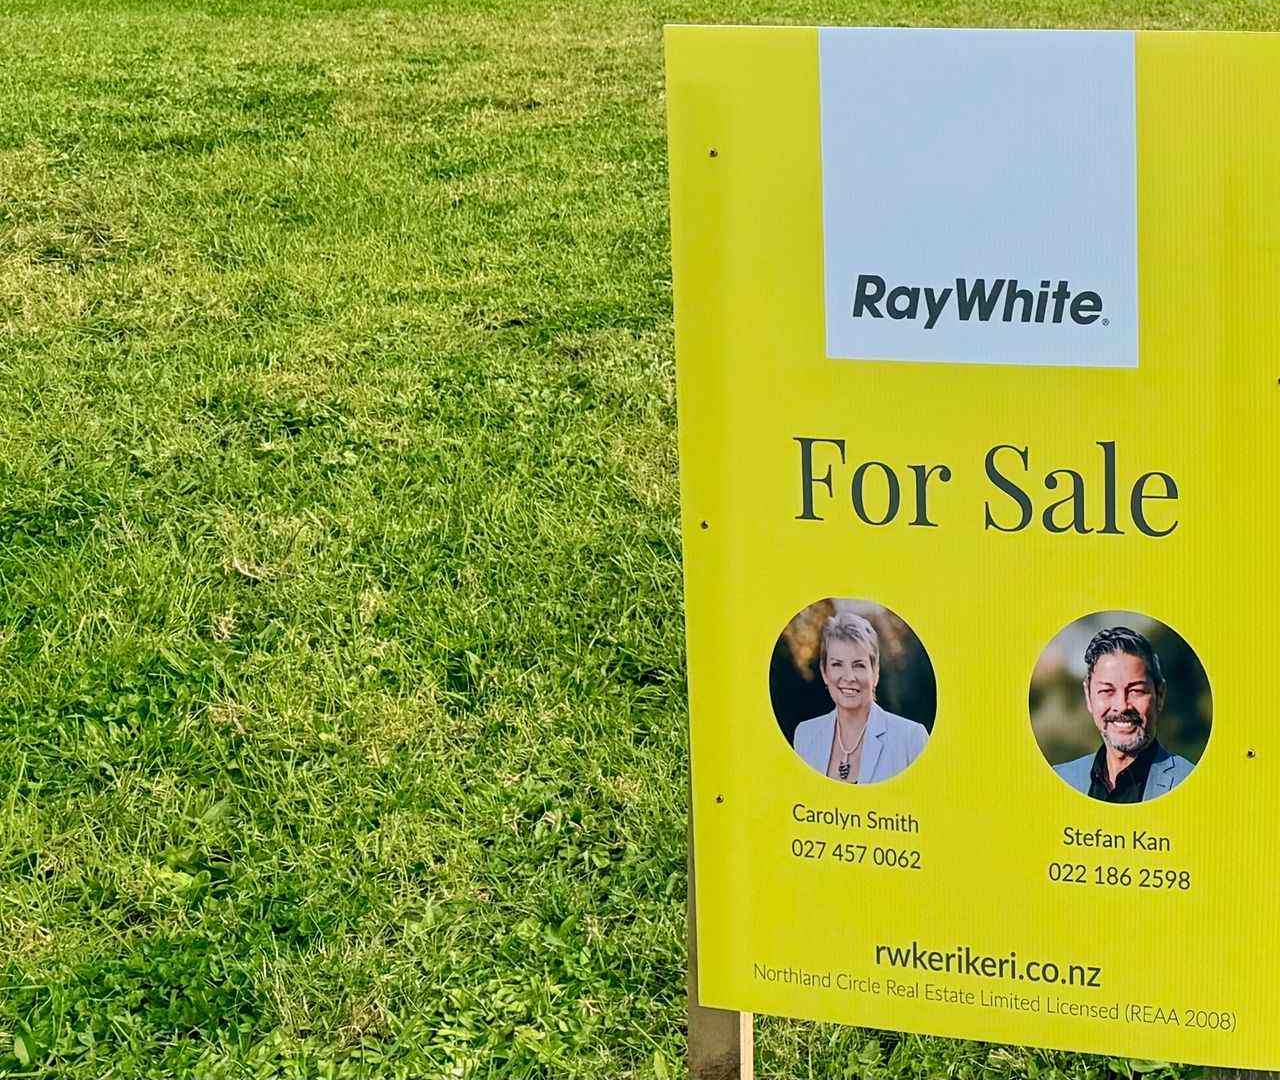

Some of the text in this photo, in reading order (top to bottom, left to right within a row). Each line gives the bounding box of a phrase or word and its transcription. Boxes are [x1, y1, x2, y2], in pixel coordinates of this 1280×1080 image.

[792, 436, 1179, 538] For Sale
[792, 803, 919, 834] Carolyn Smith
[791, 838, 922, 870] 027 457 0062
[1062, 826, 1171, 852] Stefan Kan
[1048, 862, 1191, 891] 022 186 2598
[874, 940, 1102, 988] rwkerikeri.co.nz
[754, 962, 1237, 1033] Northland Circle Real Estate Limited Licensed (REAA 2008)
